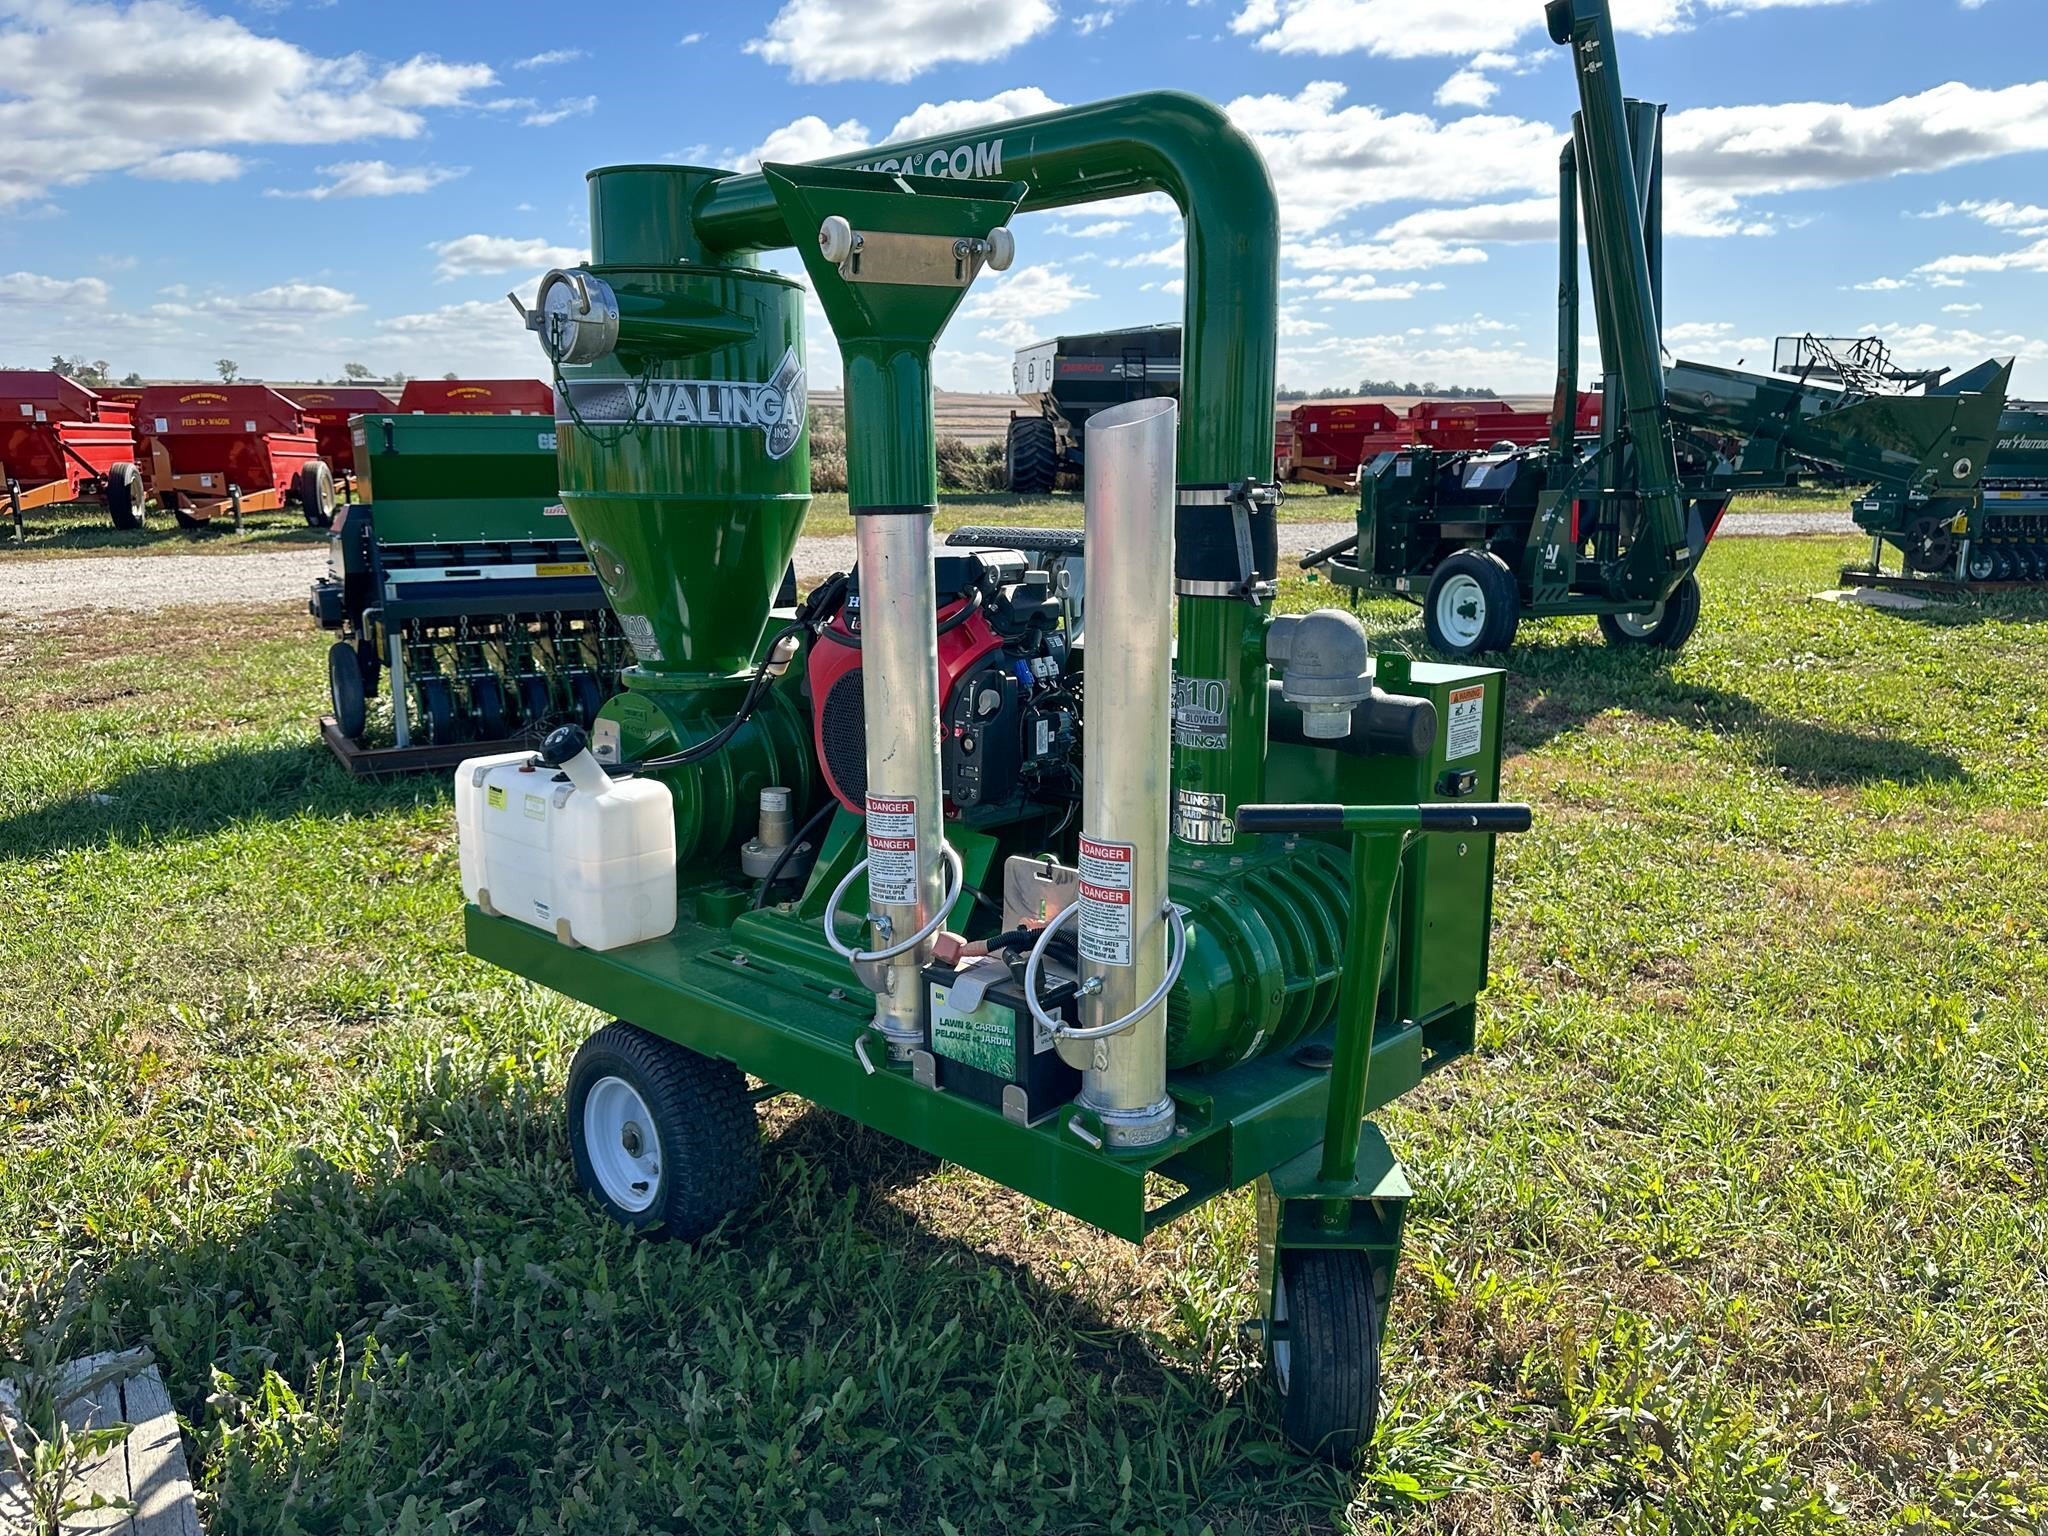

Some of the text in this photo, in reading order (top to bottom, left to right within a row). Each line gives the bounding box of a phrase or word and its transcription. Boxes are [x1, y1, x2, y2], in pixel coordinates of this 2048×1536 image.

[625, 382, 799, 425] WALINGA
[1185, 713, 1220, 725] BLOWER
[872, 802, 909, 812] DANGER
[873, 839, 910, 849] DANGER
[1084, 845, 1124, 860] DANGER
[1084, 885, 1124, 902] DANGER
[939, 1017, 1009, 1035] LAWN & GARDEN
[935, 1029, 971, 1042] PELOUSE
[980, 1036, 1011, 1047] JARDIN
